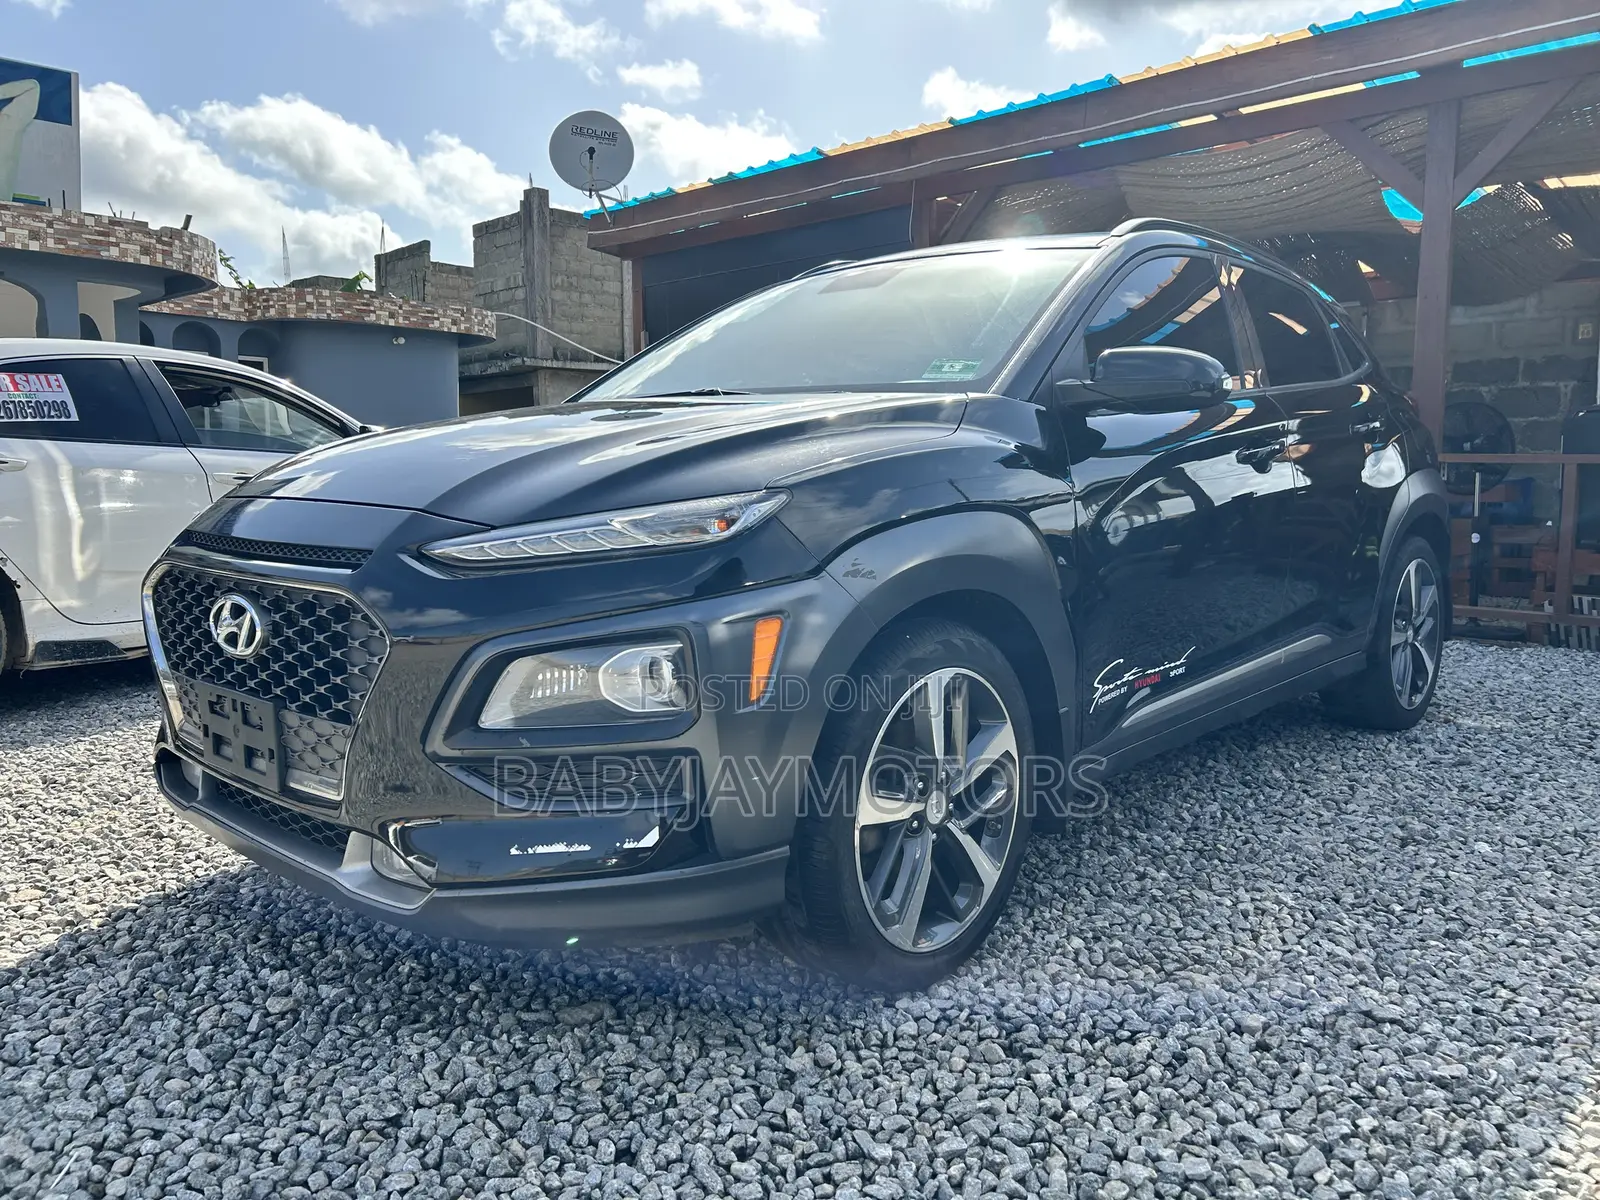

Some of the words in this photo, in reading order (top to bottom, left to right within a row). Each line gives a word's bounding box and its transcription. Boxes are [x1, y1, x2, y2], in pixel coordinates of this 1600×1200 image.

[571, 124, 618, 138] REDLINE
[14, 374, 63, 392] SALE
[1098, 689, 1120, 705] POWERED
[1120, 686, 1129, 695] BY
[1134, 673, 1161, 689] HYUNDAI
[1169, 666, 1186, 678] SPORT
